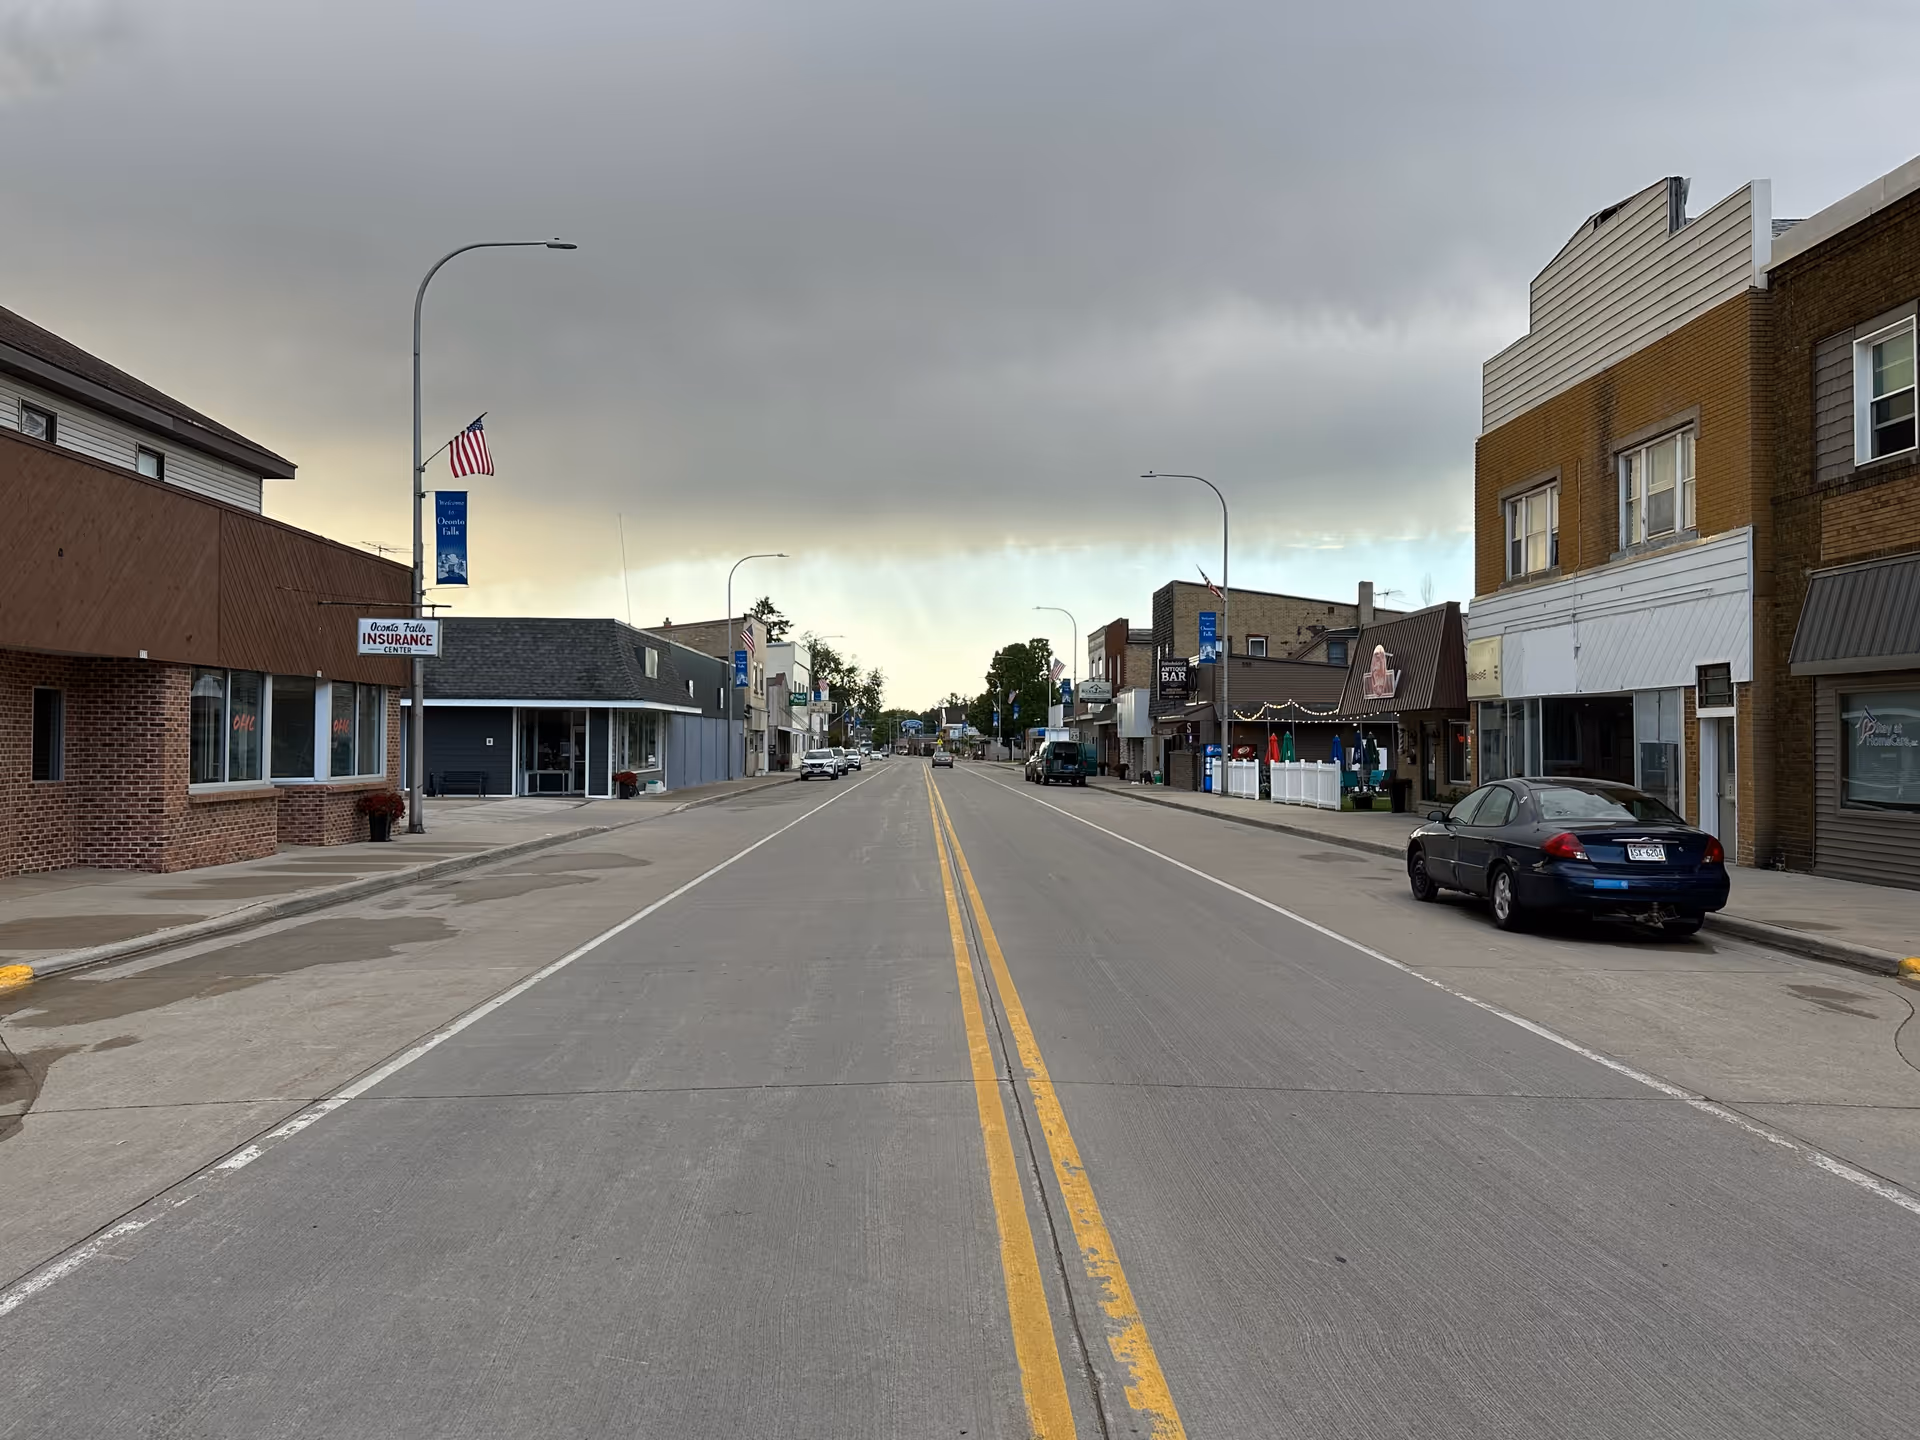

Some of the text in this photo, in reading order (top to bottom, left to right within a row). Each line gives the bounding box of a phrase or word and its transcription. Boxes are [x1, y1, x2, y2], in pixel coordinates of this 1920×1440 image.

[437, 516, 465, 525] Oconto
[442, 526, 460, 535] Falls
[370, 621, 427, 633] Oconto Falls
[362, 632, 433, 646] INSURANCE
[383, 646, 412, 654] CENTER
[1161, 671, 1187, 681] BAR
